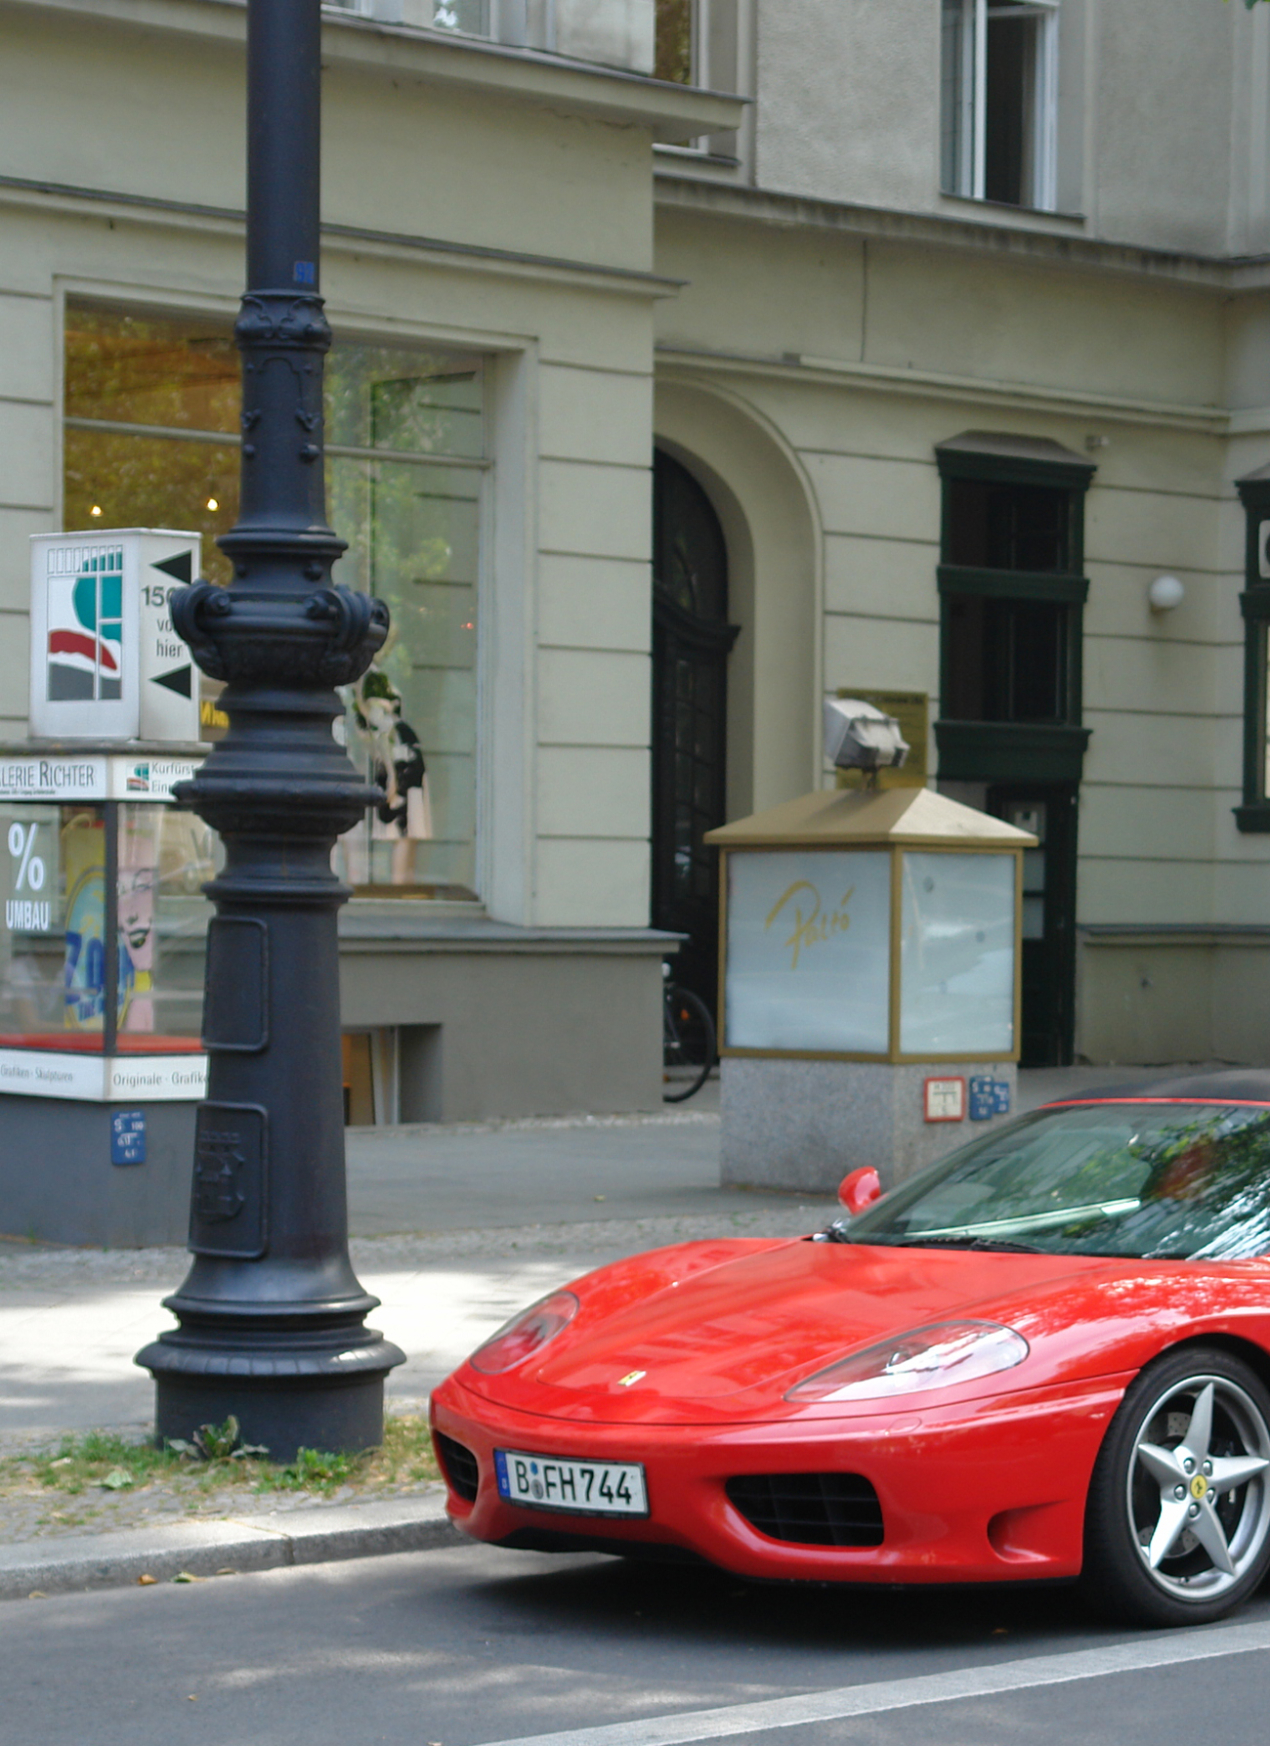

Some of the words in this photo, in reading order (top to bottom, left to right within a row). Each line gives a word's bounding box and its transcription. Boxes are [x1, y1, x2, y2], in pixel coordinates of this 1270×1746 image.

[157, 638, 183, 658] hier
[0, 764, 35, 787] LERIE
[39, 760, 95, 788] RICHTER
[5, 899, 50, 932] UMBAU
[0, 1063, 30, 1078] Grafiken
[35, 1066, 74, 1083] Skulpturen
[113, 1072, 163, 1089] Originale
